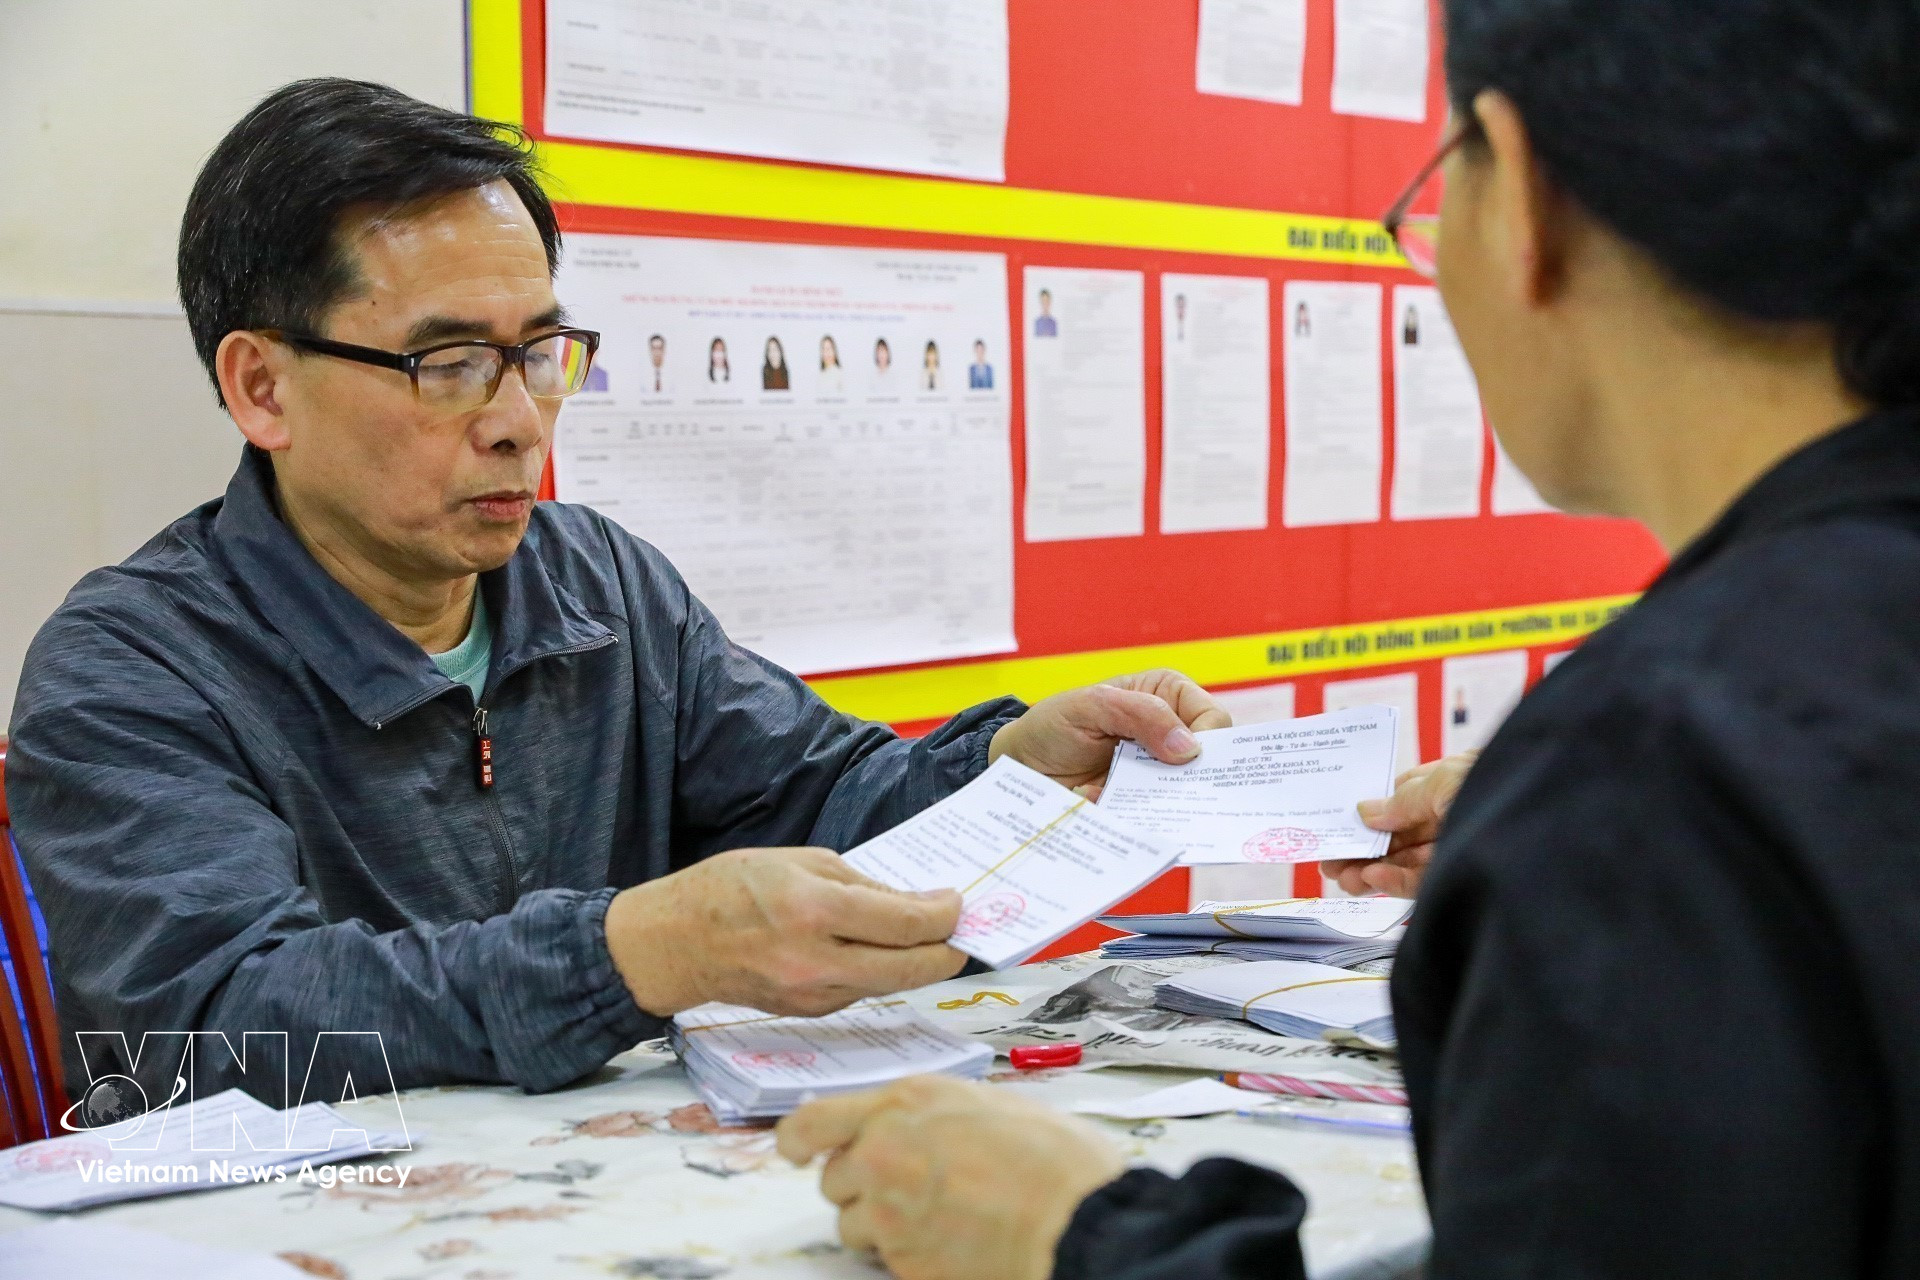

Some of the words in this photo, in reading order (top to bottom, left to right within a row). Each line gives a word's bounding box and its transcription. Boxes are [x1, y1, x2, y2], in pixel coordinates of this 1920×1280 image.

[1232, 735, 1253, 744] CỘNG
[1271, 732, 1283, 741] XÃ
[1284, 731, 1297, 740] HỘI
[1299, 728, 1315, 738] CHỦ
[1316, 727, 1339, 737] NGHĨA
[1342, 724, 1358, 735] VIỆT
[1359, 723, 1378, 731] NAM
[1313, 739, 1330, 747] Hạnh
[1330, 738, 1346, 746] phúc
[1183, 767, 1199, 776] BẦU
[1226, 765, 1244, 773] BIỂU
[1245, 763, 1266, 771] QUỐC
[1268, 762, 1281, 770] HỘI
[1213, 773, 1231, 781] BIỂU
[1232, 772, 1245, 780] HỘI
[1247, 770, 1268, 778] ĐỒNG
[1270, 769, 1292, 777] NHÂN
[1292, 767, 1309, 775] DÂN
[1310, 766, 1327, 774] CÁC
[1327, 764, 1343, 772] CẤP
[1213, 780, 1236, 788] NHIỆM
